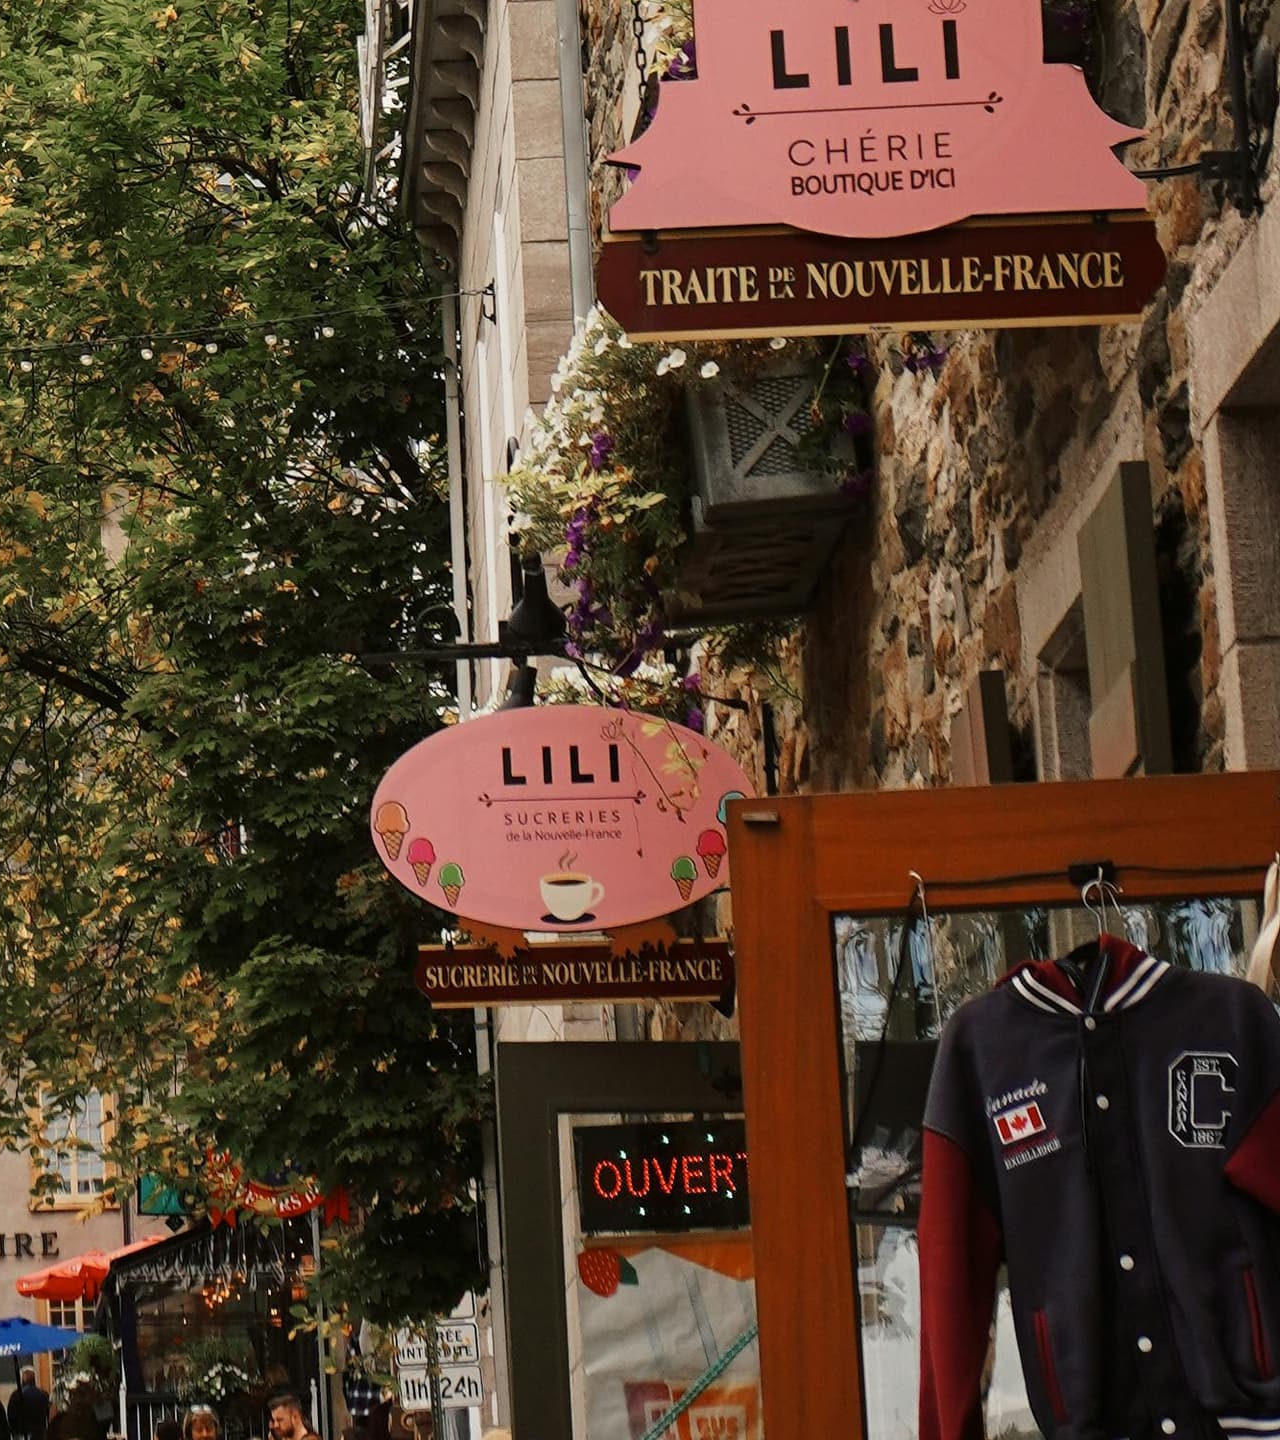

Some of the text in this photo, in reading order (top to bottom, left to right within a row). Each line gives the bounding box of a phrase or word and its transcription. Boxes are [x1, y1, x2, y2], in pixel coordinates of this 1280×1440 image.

[770, 19, 960, 90] LILI
[788, 128, 952, 167] CHÉRIE
[791, 167, 956, 196] BOUTIQUE D'ICI
[640, 251, 1125, 306] TRAITE DE LA NOUVELLE-FRANCE
[502, 744, 620, 785] LILI
[504, 809, 621, 826] SUCRERIES
[506, 828, 622, 842] de la Nouvelle-France
[425, 964, 520, 988] SUCRERIE
[542, 958, 722, 986] NOUVELLE-FRANCE
[1003, 1136, 1062, 1171] EXCELLENCE
[440, 1375, 479, 1399] 24h
